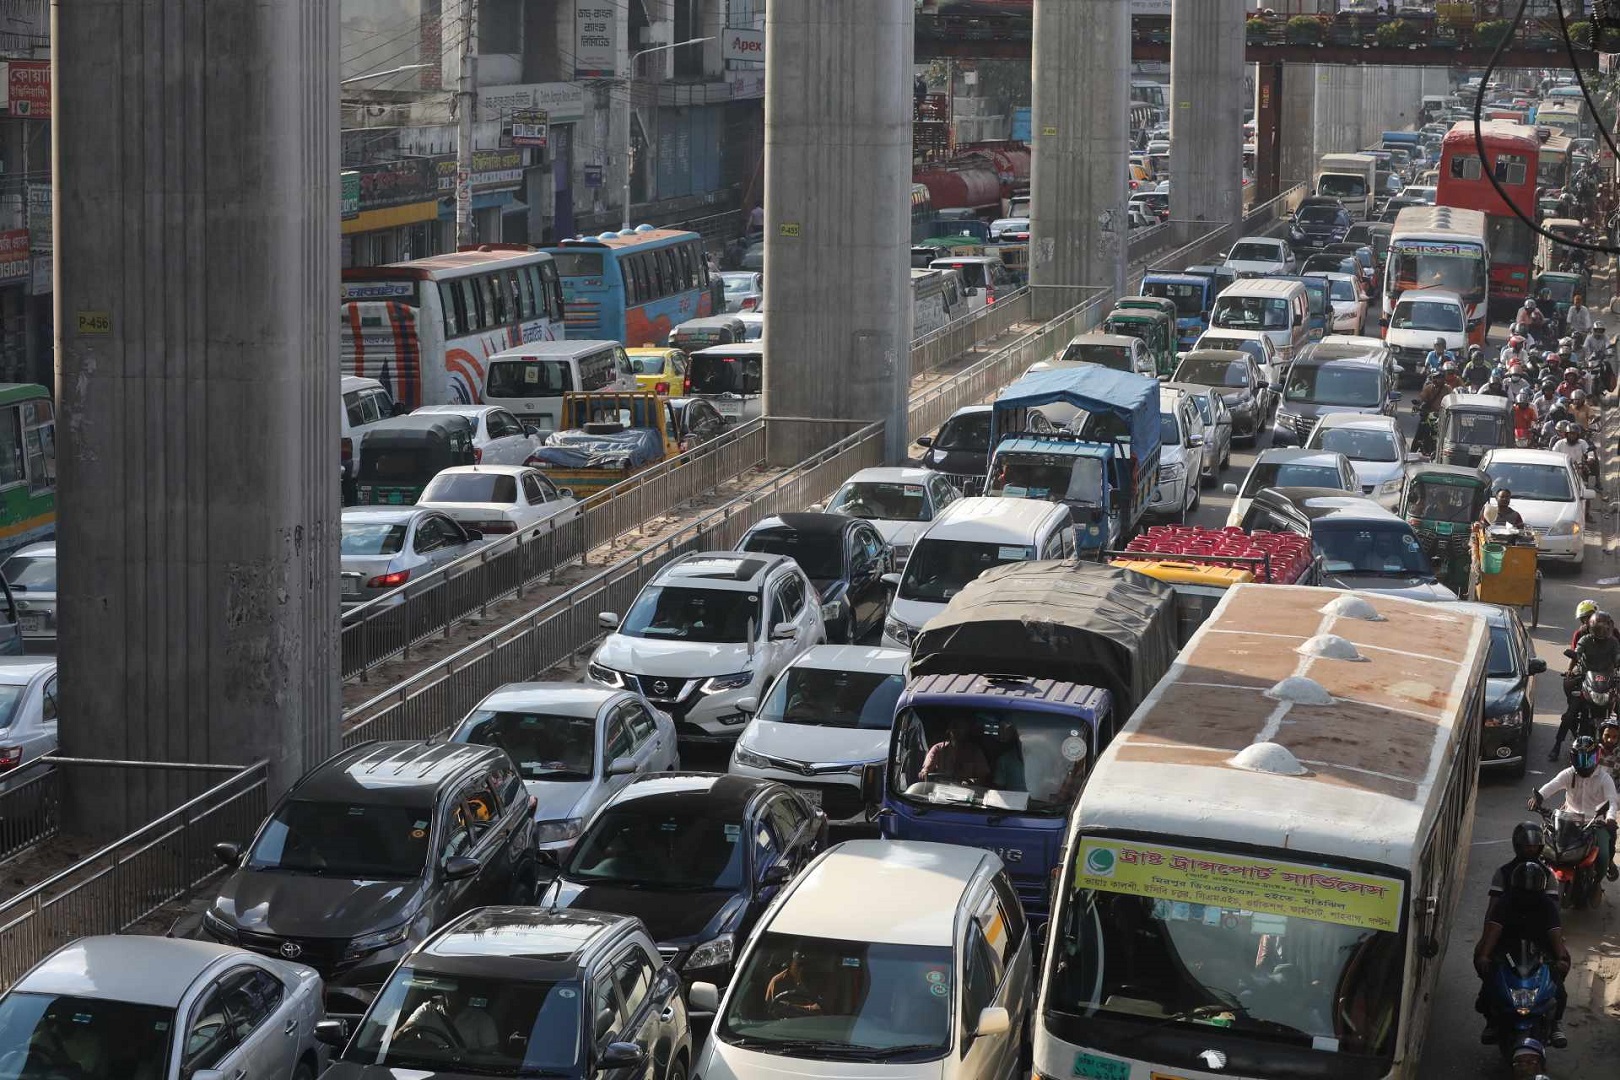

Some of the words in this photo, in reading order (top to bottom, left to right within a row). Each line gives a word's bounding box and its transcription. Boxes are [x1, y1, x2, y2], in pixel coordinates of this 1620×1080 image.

[731, 36, 762, 53] Apex
[79, 316, 109, 329] P-456
[1152, 875, 1187, 888] মিরপুর
